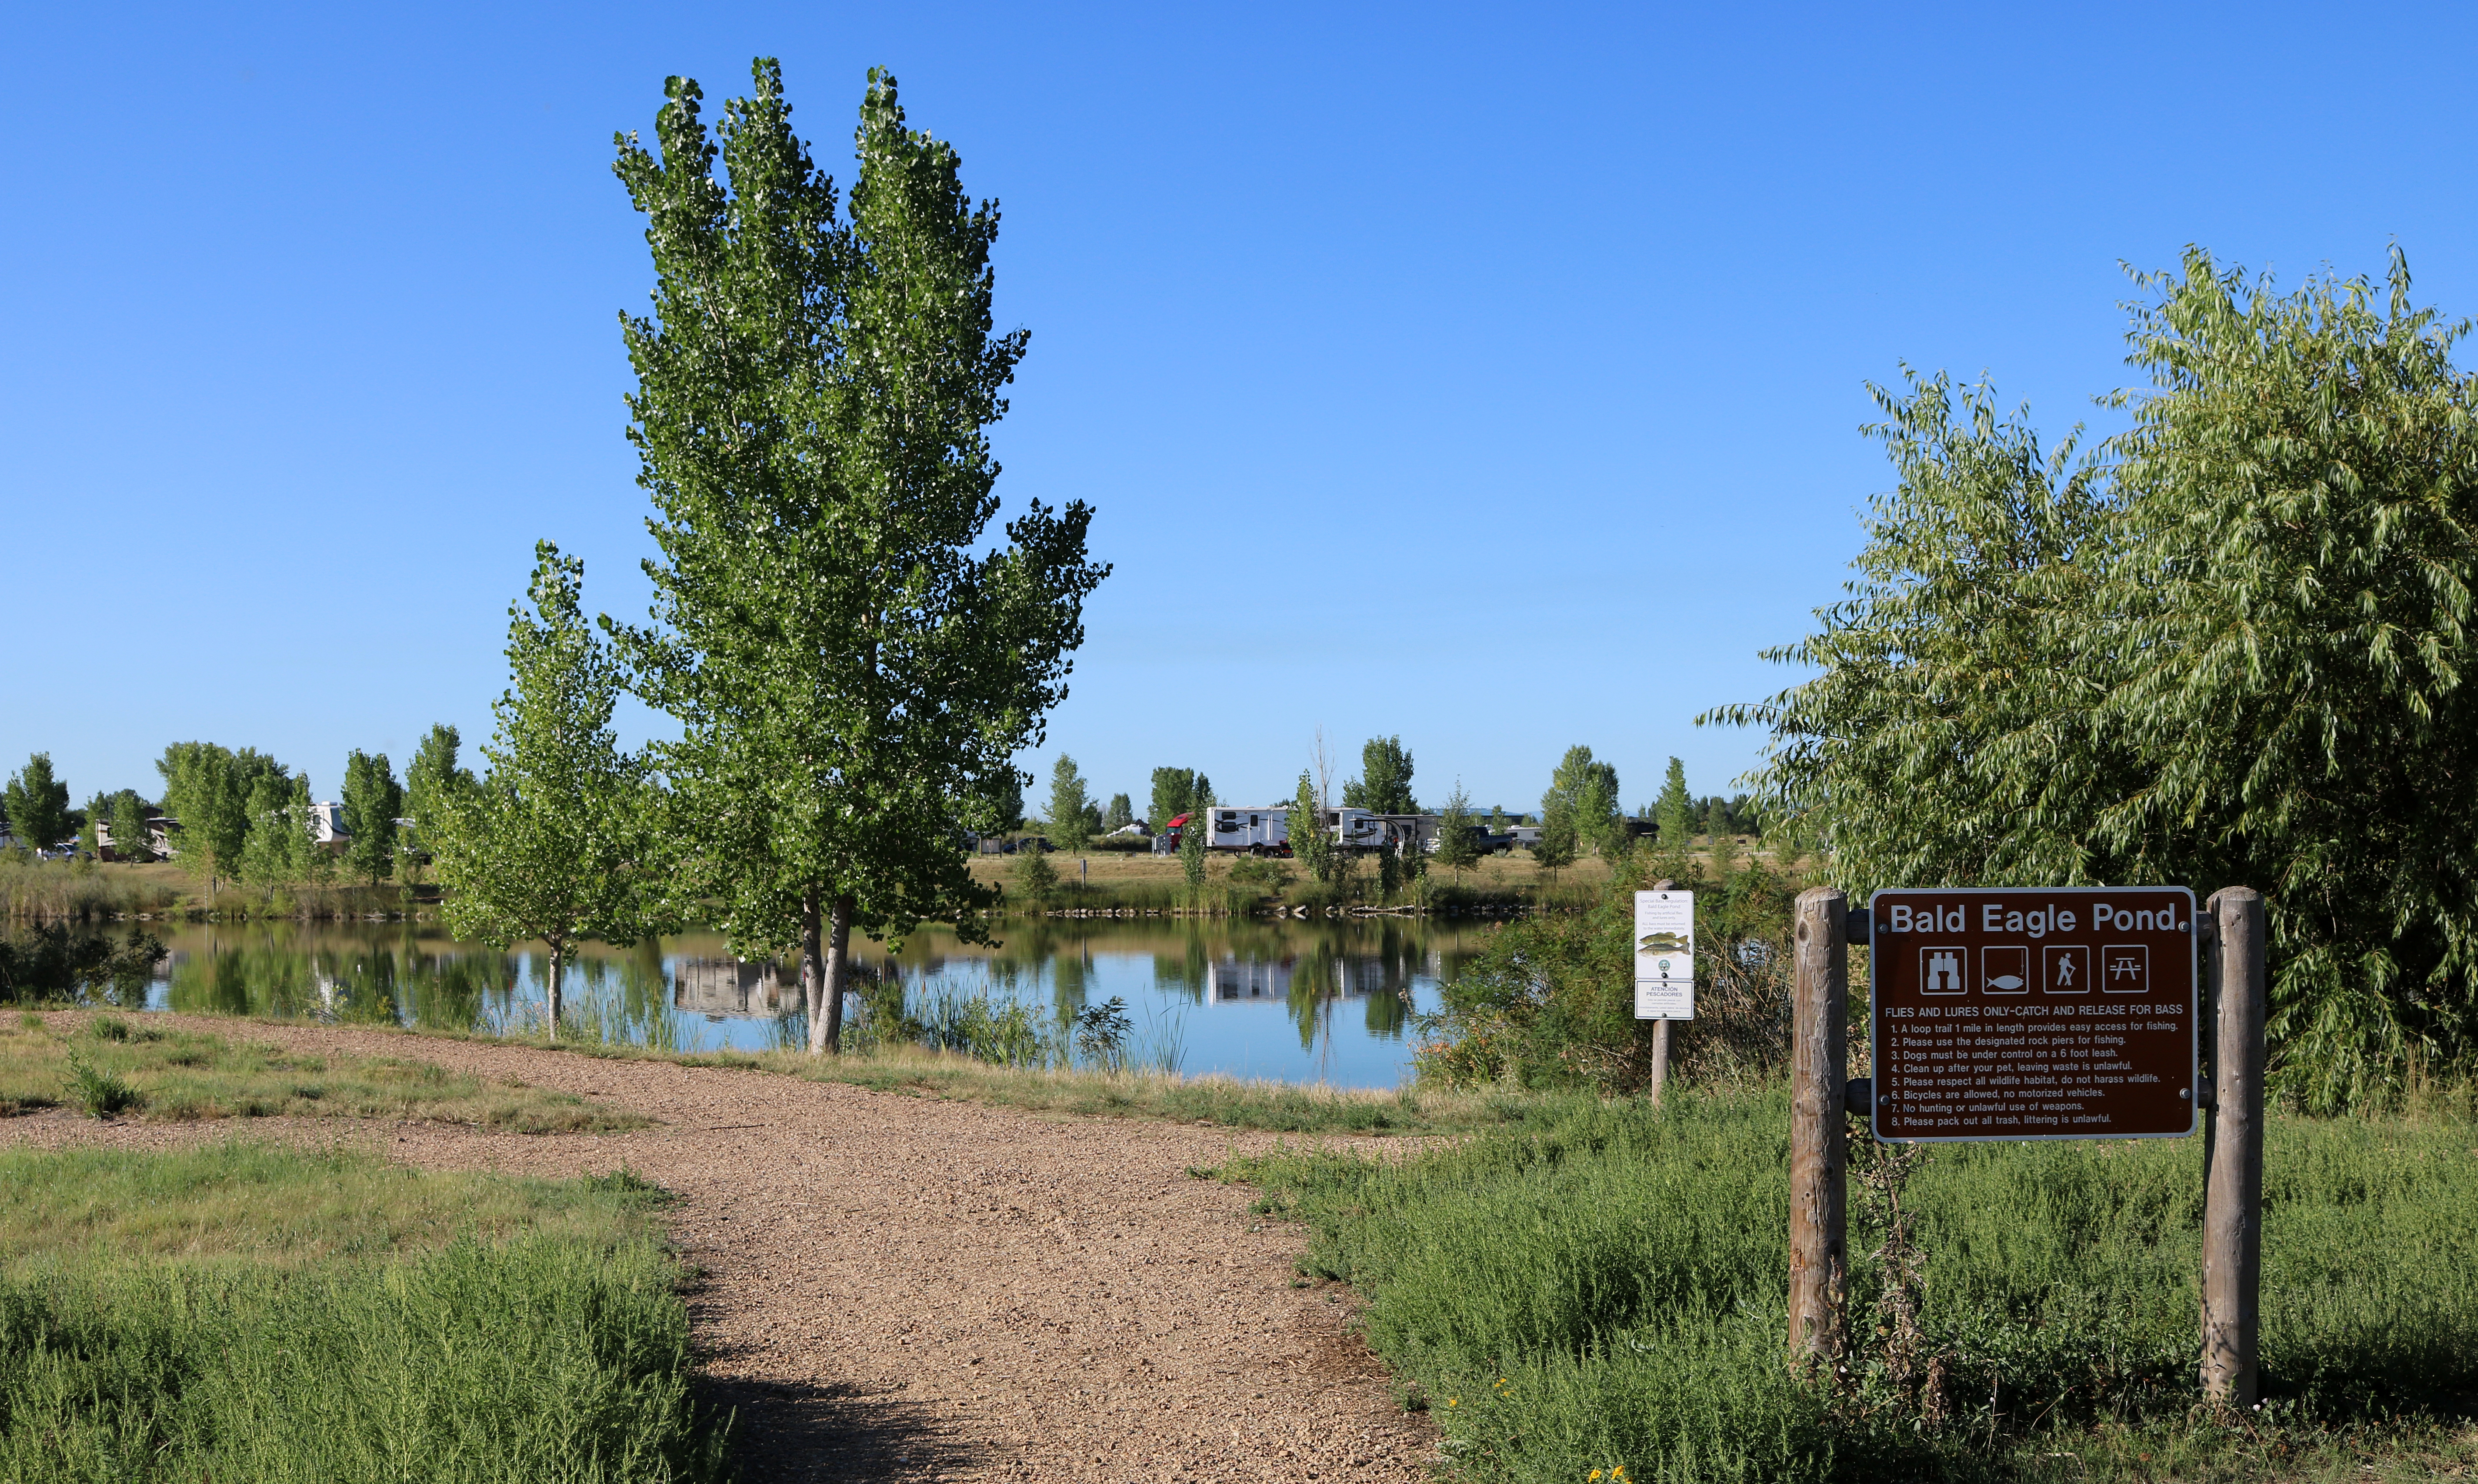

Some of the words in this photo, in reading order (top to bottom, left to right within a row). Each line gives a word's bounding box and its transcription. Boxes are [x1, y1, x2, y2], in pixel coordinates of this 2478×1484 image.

[1891, 904, 1965, 933] Bald
[1982, 904, 2076, 938] Eagle
[2093, 903, 2175, 931] Pond
[1885, 1007, 1914, 1017] FLIES
[1918, 1007, 1941, 1017] AND
[1945, 1007, 1979, 1017] LURES
[2053, 1006, 2074, 1015] AND
[2079, 1005, 2125, 1015] RELEASE
[2130, 1004, 2151, 1014] FOR
[2155, 1004, 2183, 1014] BASS
[1891, 1024, 1898, 1033] 1.
[1901, 1024, 1908, 1033] A
[1911, 1024, 1931, 1035] loop
[1935, 1024, 1952, 1033] trail
[1955, 1024, 1959, 1032] 1
[1963, 1023, 1981, 1032] mile
[1985, 1023, 1993, 1032] in
[1996, 1023, 2024, 1034] length
[2028, 1022, 2066, 1033] provides
[2070, 1024, 2091, 1032] easy
[2130, 1021, 2143, 1030] for
[2146, 1021, 2178, 1031] fishing.
[1891, 1037, 1899, 1046] 2.
[1903, 1037, 1933, 1046] Please
[1956, 1037, 1971, 1046] the
[1975, 1036, 2024, 1047] designated
[2028, 1036, 2048, 1045] rock
[2052, 1035, 2074, 1046] piers
[2078, 1035, 2091, 1044] for
[2094, 1035, 2126, 1045] fishing.
[1891, 1051, 1900, 1060] 3.
[1903, 1051, 1927, 1062] Dogs
[1931, 1050, 1953, 1059] must
[1957, 1050, 1968, 1059] be
[1972, 1049, 1997, 1059] under
[2001, 1049, 2032, 1059] control
[2060, 1049, 2066, 1058] 6
[2070, 1049, 2088, 1057] foot
[2092, 1048, 2118, 1057] leash.
[1891, 1064, 1900, 1073] 4.
[1904, 1064, 1929, 1073] Clean
[1933, 1066, 1944, 1074] up
[1948, 1063, 1970, 1072] after
[1973, 1065, 1993, 1074] your
[1997, 1063, 2014, 1073] pet,
[2017, 1062, 2049, 1073] leaving
[2052, 1062, 2079, 1071] waste
[2083, 1062, 2090, 1070] is
[2094, 1061, 2132, 1070] unlawful.
[1892, 1077, 1900, 1087] 5.
[1904, 1077, 1934, 1086] Please
[1937, 1076, 1972, 1087] respect
[1975, 1076, 1986, 1085] all
[1989, 1076, 2021, 1085] wildlife
[2024, 1075, 2057, 1085] habitat,
[2061, 1075, 2073, 1084] do
[2077, 1075, 2091, 1083] not
[2094, 1074, 2124, 1083] harass
[2127, 1073, 2160, 1083] wildlife.
[1892, 1090, 1900, 1100] 6.
[1904, 1090, 1941, 1101] Bicycles
[1964, 1089, 2000, 1099] allowed,
[2019, 1088, 2063, 1097] motorized
[2066, 1088, 2105, 1097] vehicles.
[1892, 1104, 1899, 1113] 7.
[1903, 1104, 1916, 1112] No
[1920, 1103, 1952, 1114] hunting
[1969, 1102, 2006, 1111] unlawful
[2029, 1102, 2038, 1111] of
[2042, 1103, 2084, 1112] weapons.
[1892, 1117, 1900, 1126] 8.
[1904, 1117, 1934, 1126] Please
[1937, 1116, 1959, 1127] pack
[1963, 1116, 1978, 1125] out
[1982, 1115, 1992, 1125] all
[1996, 1115, 2021, 1125] trash,
[2024, 1115, 2058, 1125] littering
[2062, 1115, 2069, 1123] is
[2073, 1114, 2111, 1123] unlawful.
